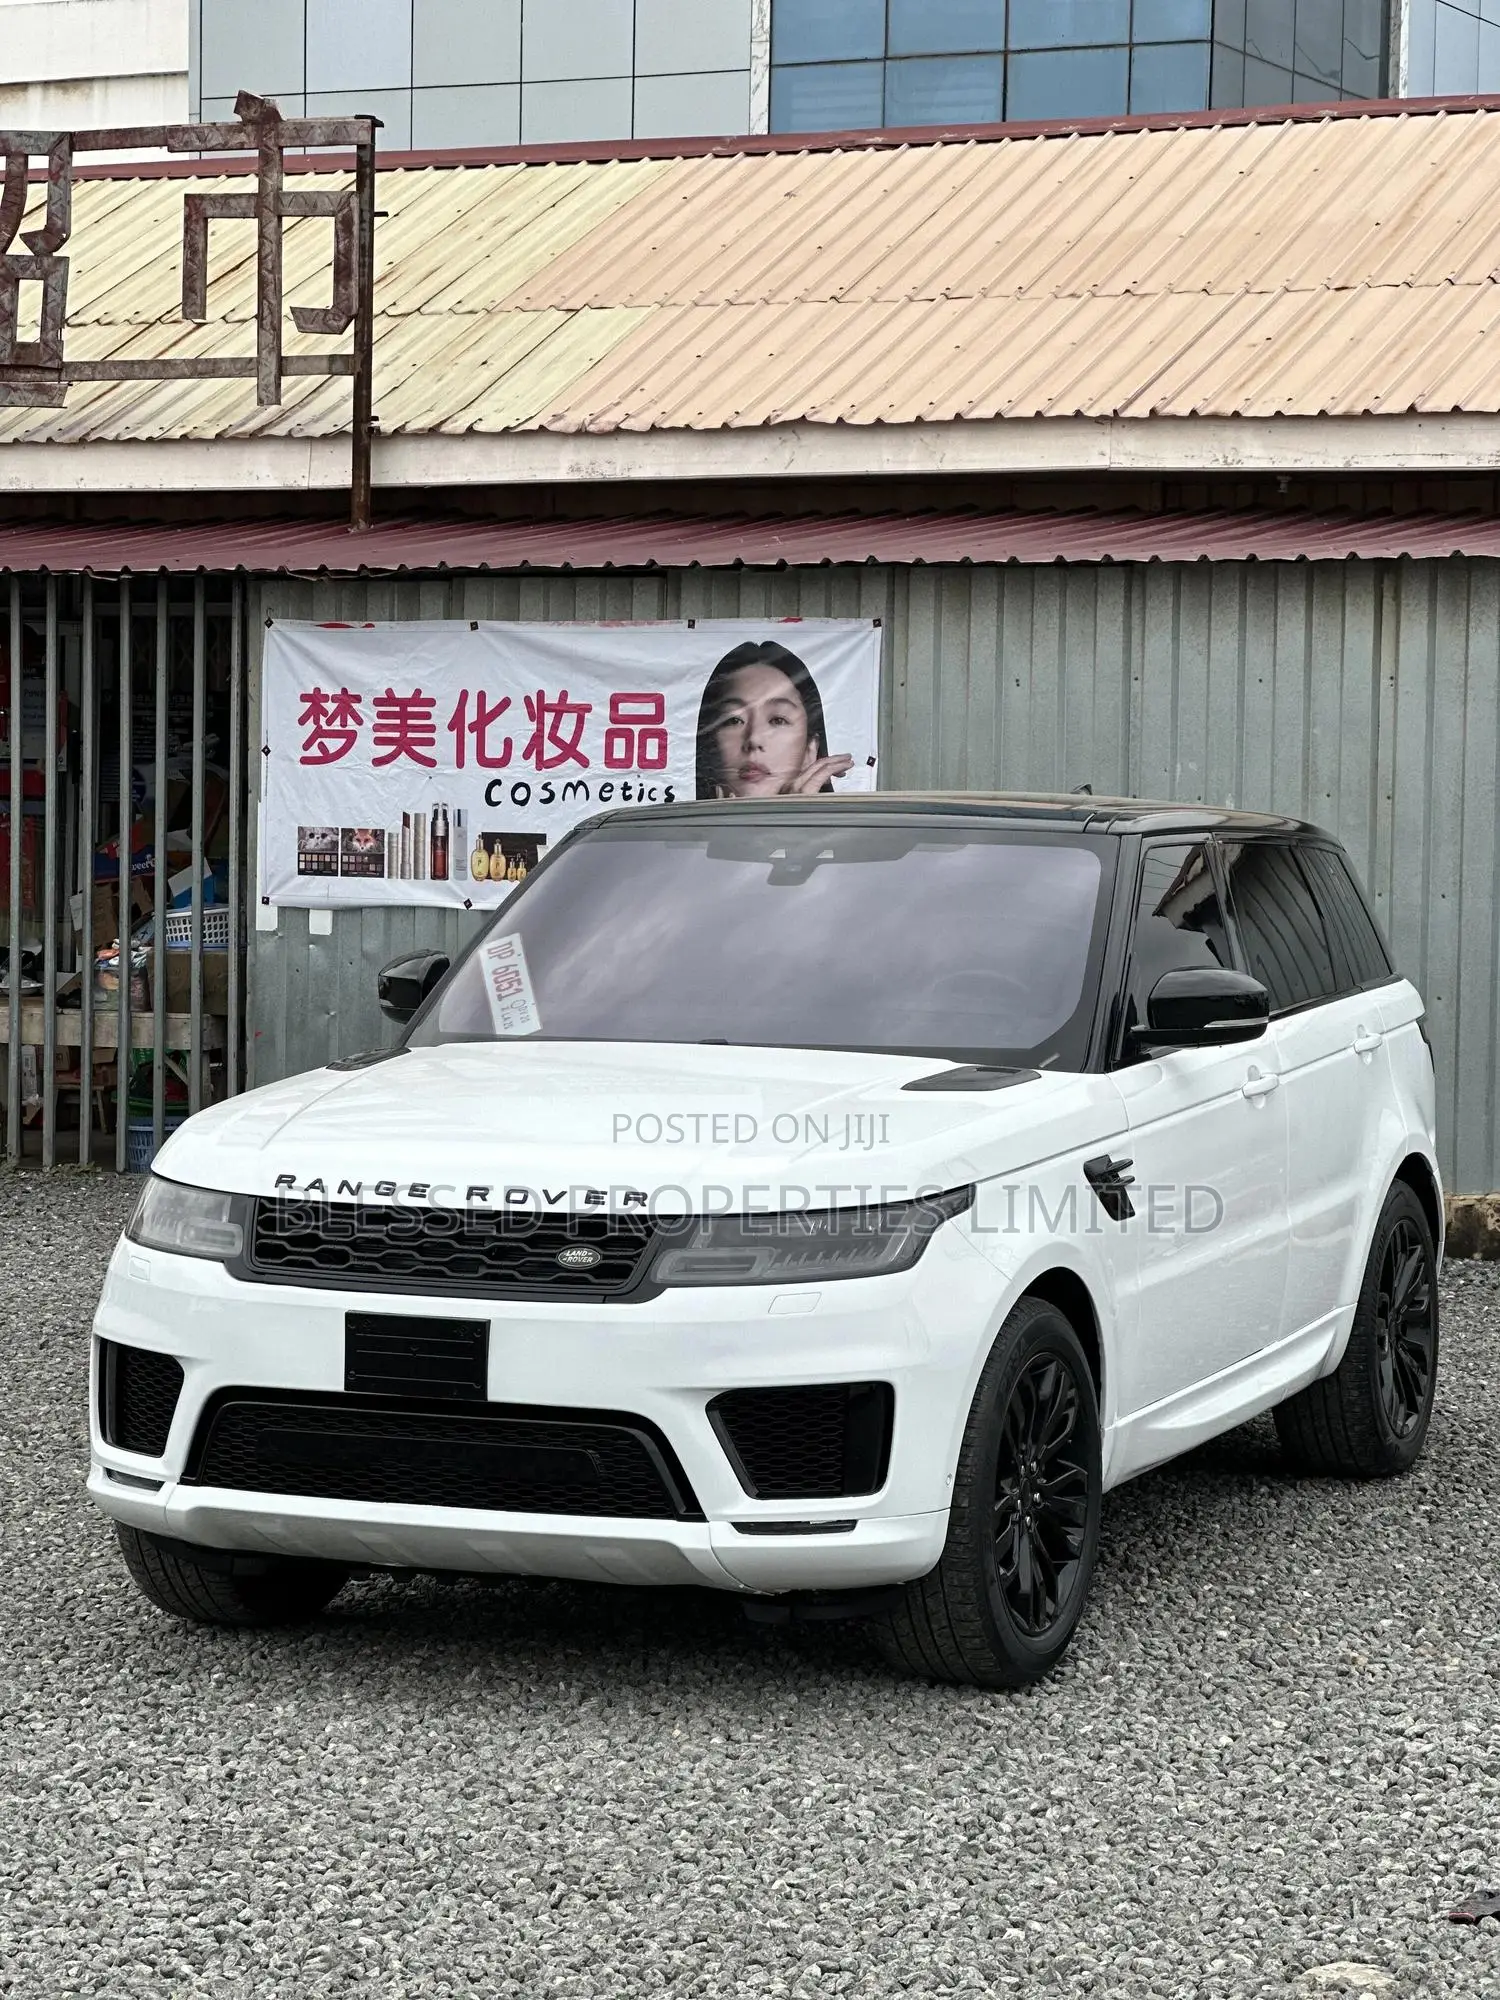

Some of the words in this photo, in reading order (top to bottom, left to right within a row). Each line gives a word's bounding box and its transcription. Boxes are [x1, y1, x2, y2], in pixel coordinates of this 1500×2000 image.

[297, 686, 669, 771] 梦美化妆品
[486, 940, 516, 960] DP
[491, 963, 524, 1002] 6051
[274, 1173, 431, 1199] RANGE
[465, 1185, 649, 1208] ROVER
